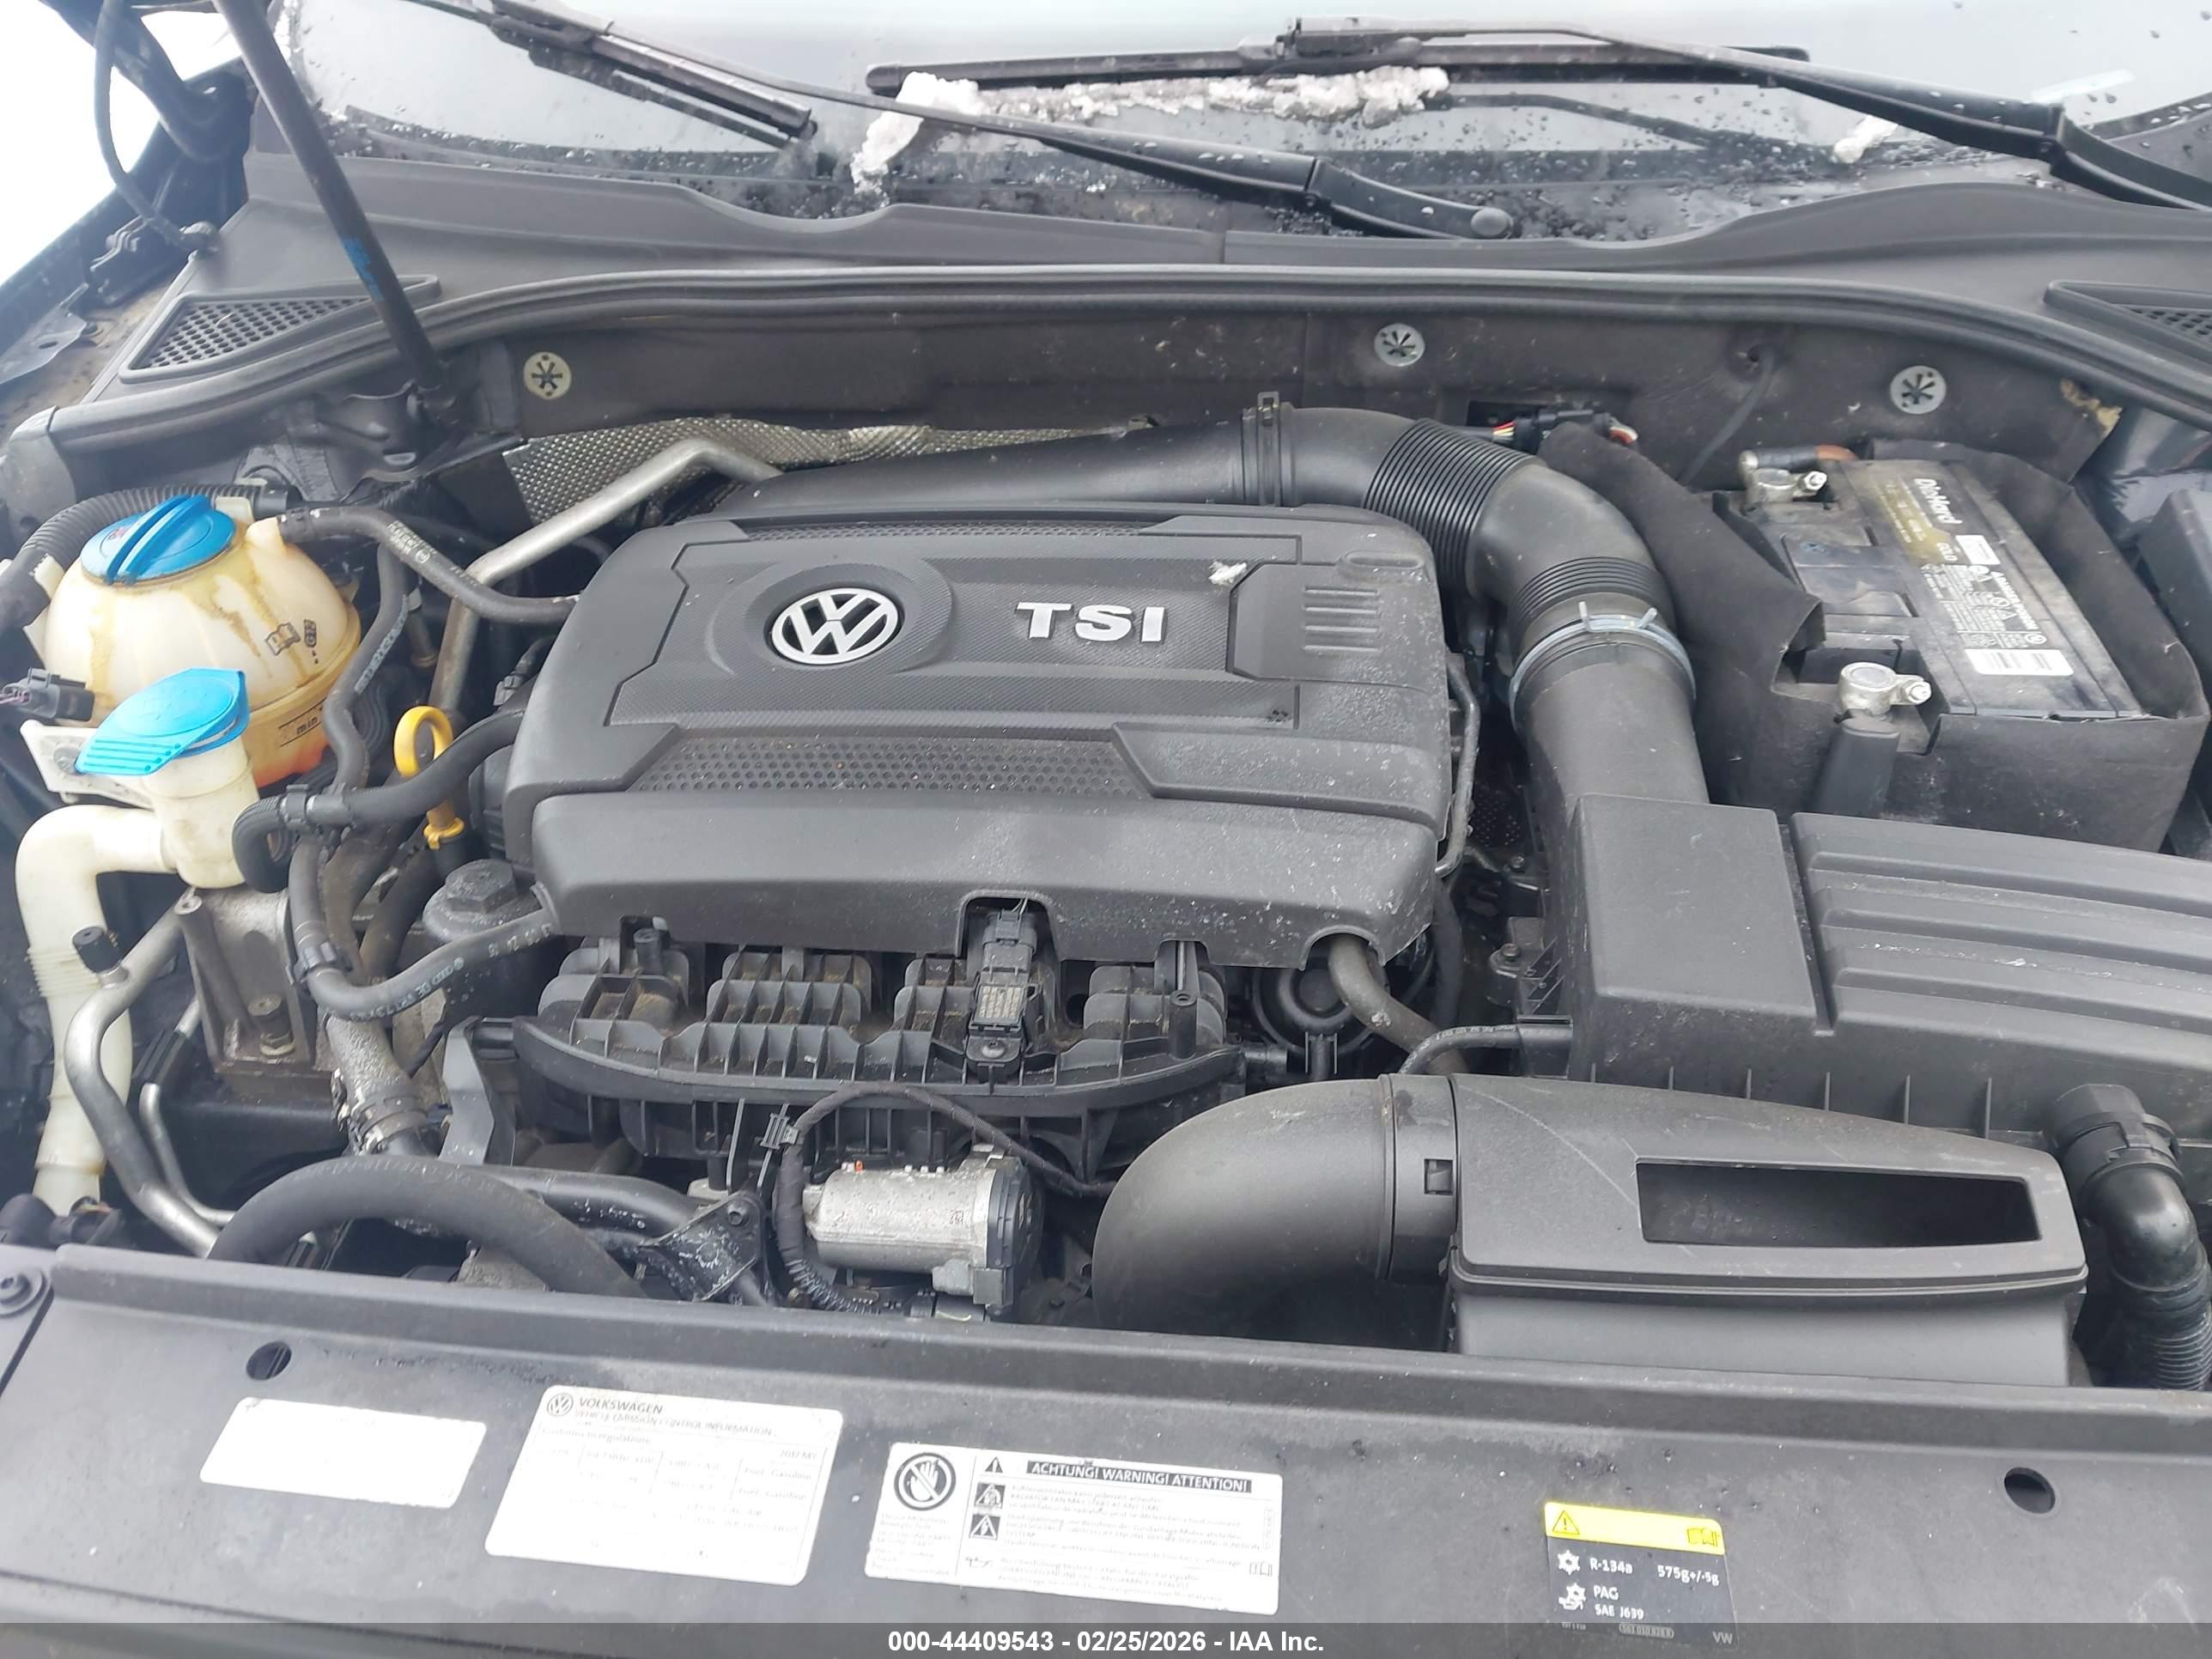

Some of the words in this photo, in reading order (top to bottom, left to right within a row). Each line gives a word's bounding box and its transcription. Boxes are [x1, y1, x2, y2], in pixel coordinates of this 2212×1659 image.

[1913, 477, 1964, 525] DieHard
[1016, 601, 1167, 644] TSI
[579, 1396, 664, 1415] VOLKSWAGEN
[705, 1421, 774, 1437] INFORMATION
[1031, 1462, 1099, 1480] ACHTUNG!
[1102, 1469, 1170, 1486] WARNING!
[1171, 1474, 1249, 1492] ATTENTION!
[1589, 1558, 1634, 1574] R-134a
[1593, 1584, 1620, 1601] PAG
[1595, 1604, 1615, 1617] SAE
[1620, 1607, 1645, 1620] J639
[1712, 1631, 1733, 1645] VW
